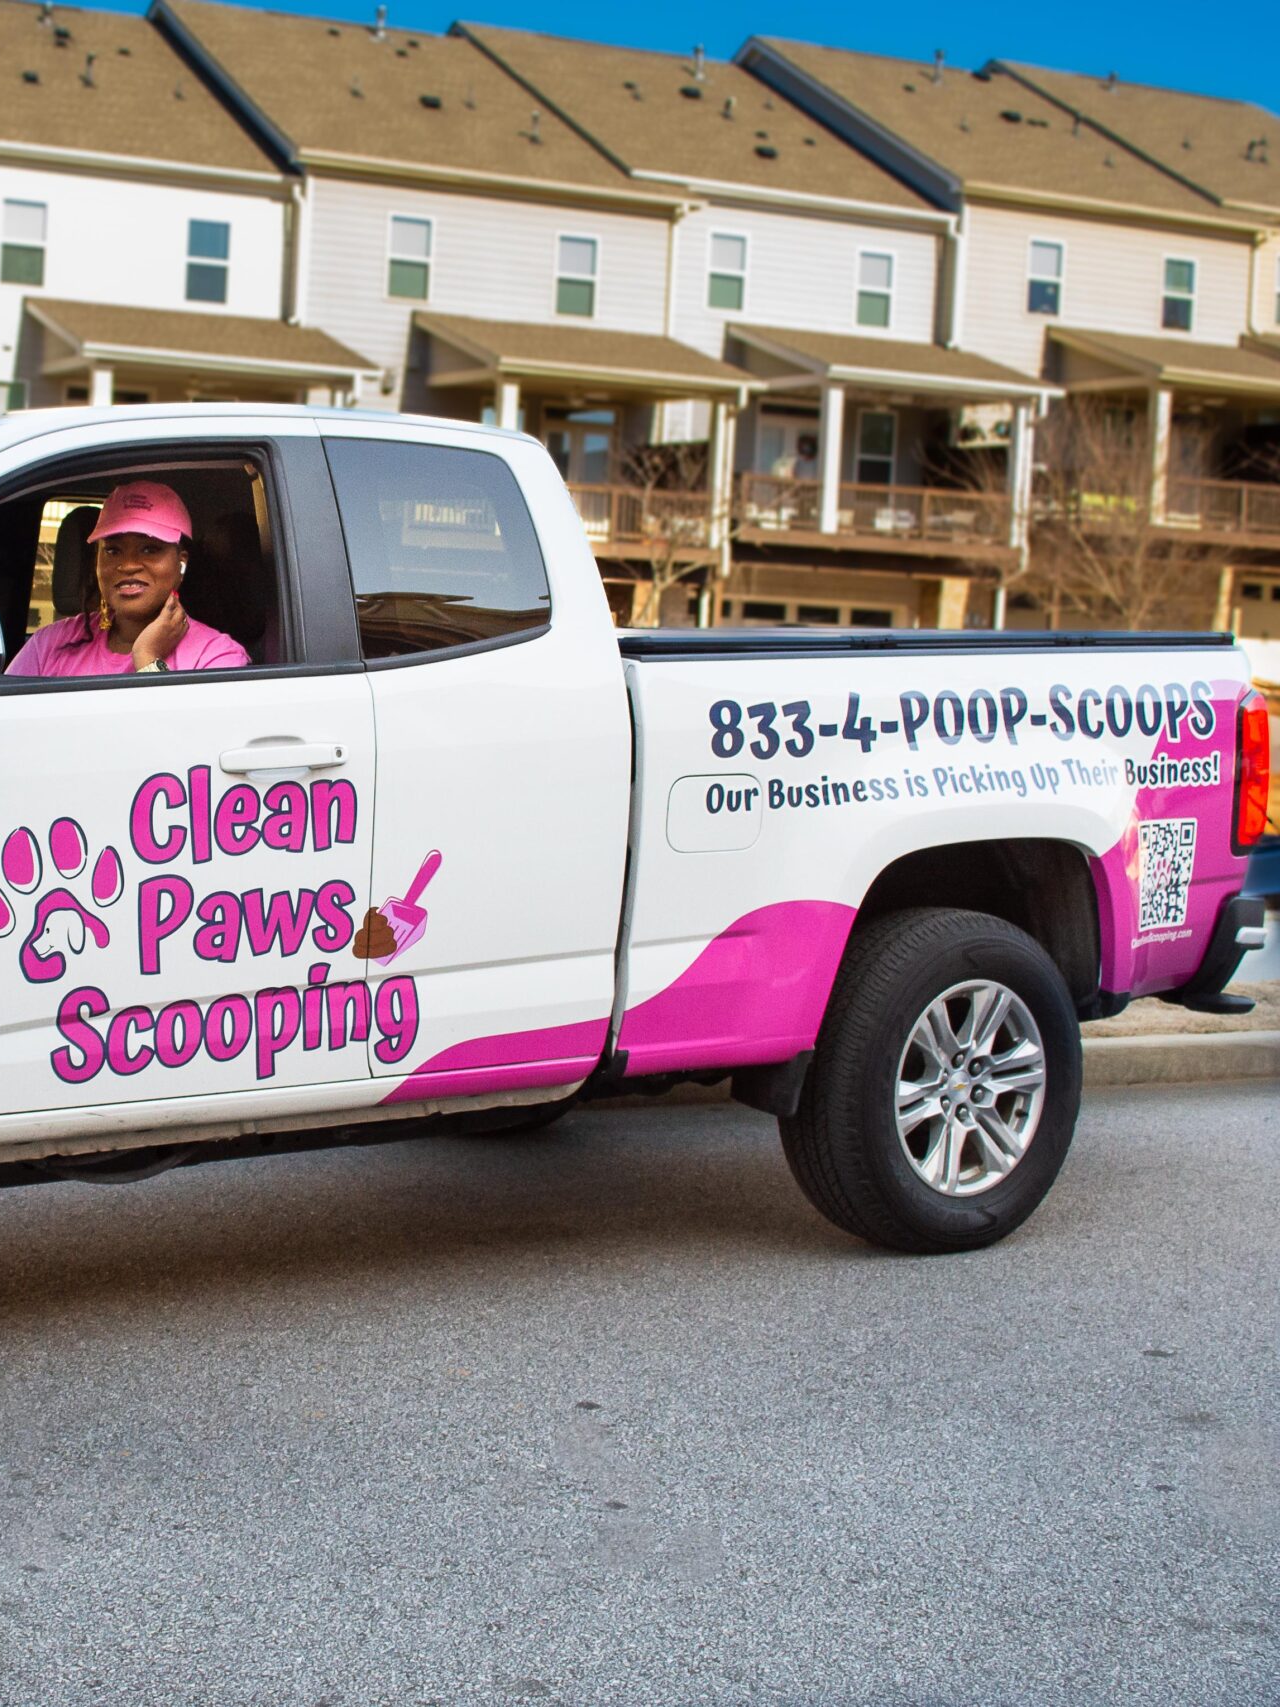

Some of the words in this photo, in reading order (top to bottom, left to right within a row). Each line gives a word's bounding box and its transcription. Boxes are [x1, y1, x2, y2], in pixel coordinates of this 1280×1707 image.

[708, 681, 1216, 760] 833-4-POOP-SCOOPS
[129, 764, 358, 865] Clean
[706, 783, 759, 814] Our
[768, 775, 900, 810] Business
[903, 768, 929, 798] is
[932, 763, 1028, 797] Picking
[1029, 762, 1060, 794] Up
[1061, 757, 1119, 788] Their
[1124, 754, 1220, 787] Business!
[138, 874, 357, 975] Paws
[50, 963, 420, 1085] Scooping
